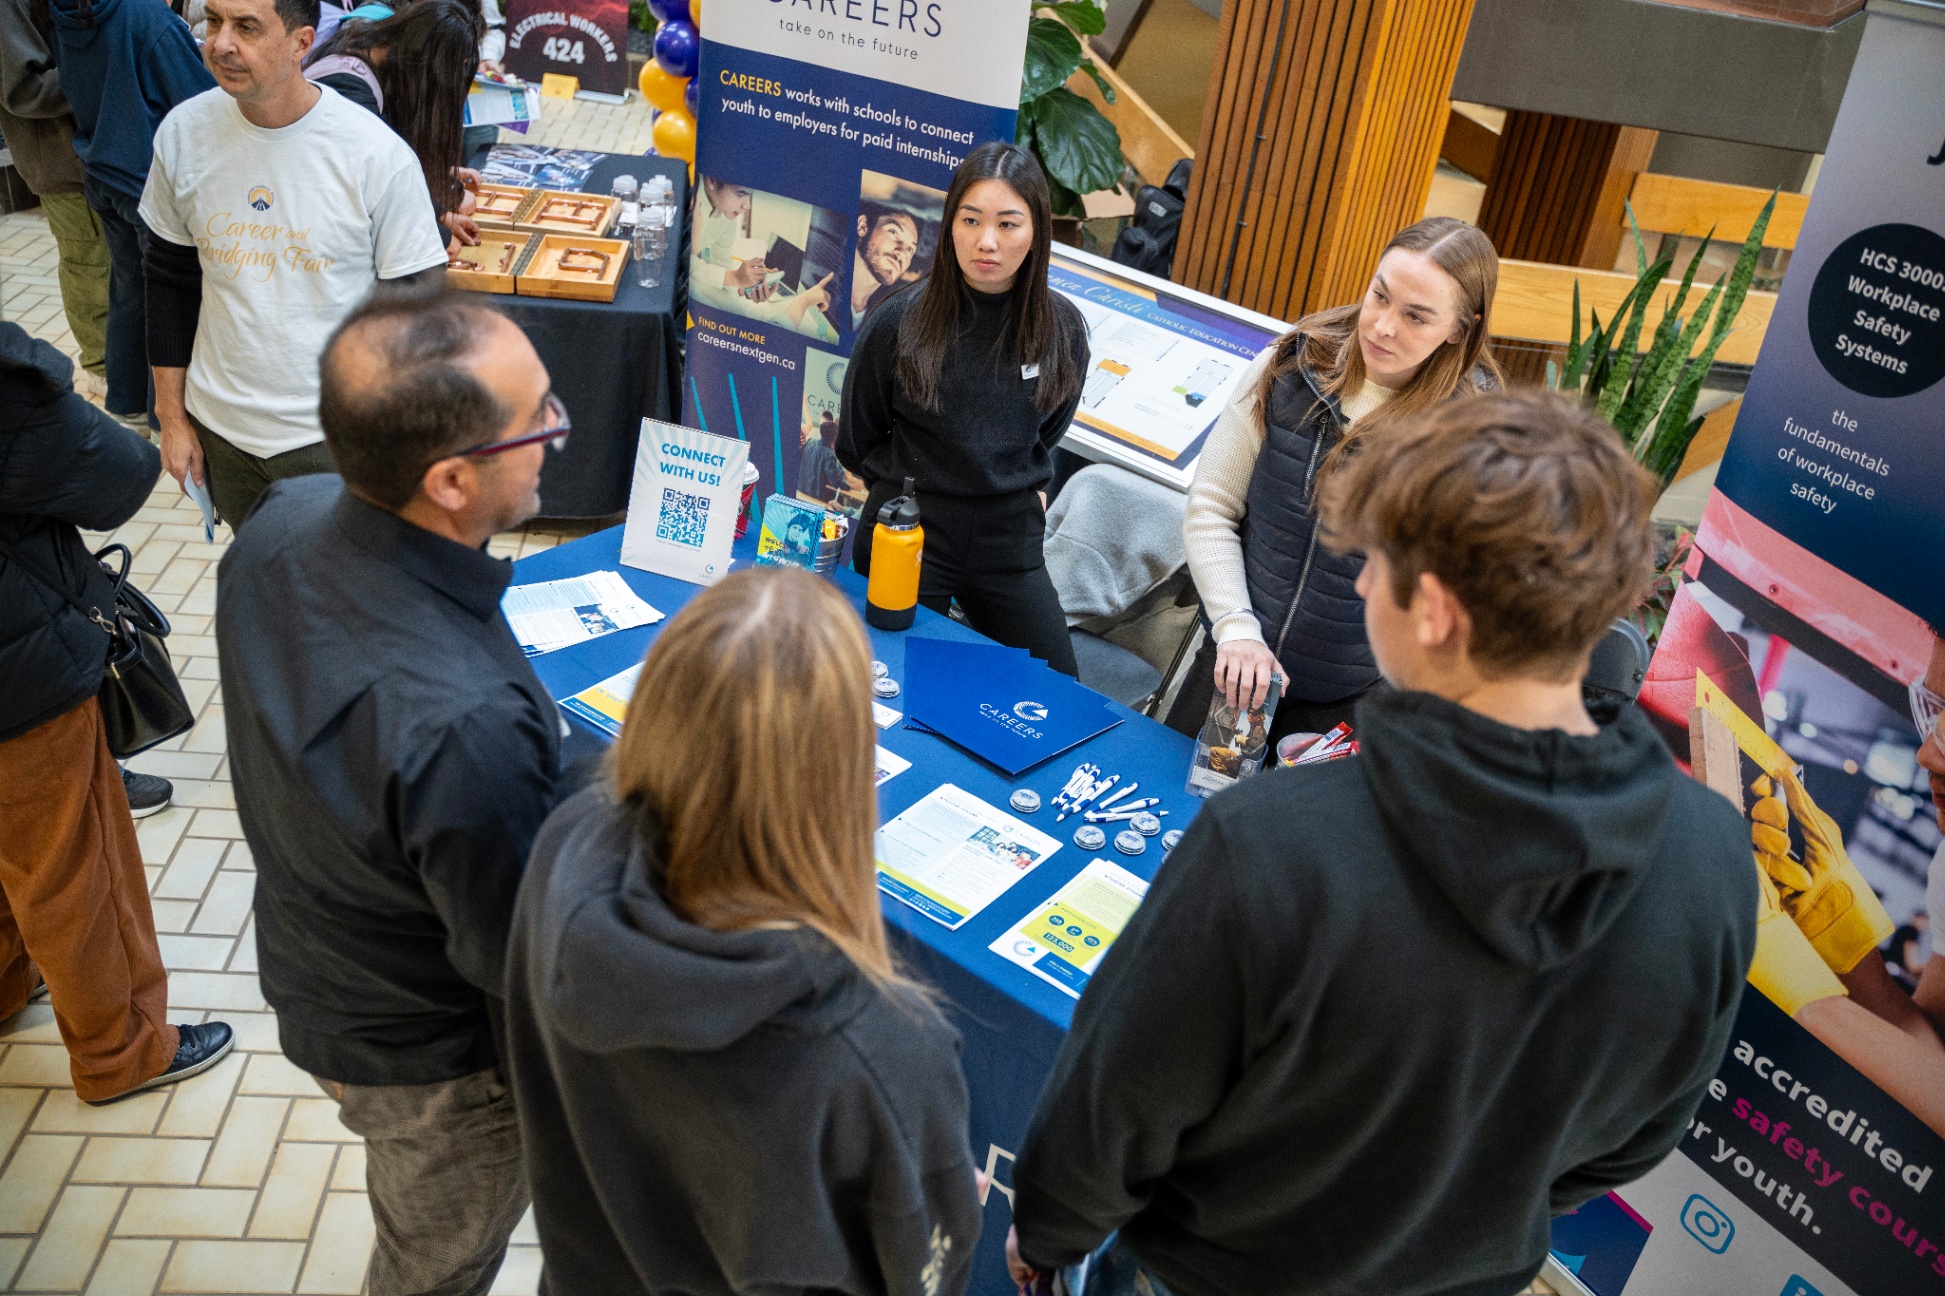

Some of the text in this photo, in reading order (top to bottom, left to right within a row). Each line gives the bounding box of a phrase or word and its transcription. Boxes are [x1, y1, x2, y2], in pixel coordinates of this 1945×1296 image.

[508, 11, 618, 62] ELECTRICAL WORKERS
[769, 0, 942, 38] EERS
[780, 18, 918, 60] take on the future
[542, 36, 585, 65] 424
[720, 69, 974, 145] CAREERS works with schools to connect
[721, 97, 755, 116] youth
[758, 103, 771, 119] to
[774, 111, 837, 136] employers
[840, 122, 860, 142] for
[862, 132, 893, 150] paid
[206, 212, 311, 241] Career and
[195, 237, 335, 283] Bridging Fair
[1860, 247, 1898, 274] HCS
[1048, 274, 1082, 291] men
[1147, 312, 1190, 332] CATHOLIC
[1188, 327, 1240, 351] EDUCATION
[1239, 346, 1258, 358] CEN
[1847, 274, 1941, 322] Workplace
[698, 316, 766, 345] FIND OUT MORE
[1853, 309, 1912, 346] Safety
[697, 331, 796, 371] careersnextgen.ca
[1835, 333, 1908, 375] Systems
[807, 394, 841, 414] CARE
[1831, 409, 1858, 432] the
[661, 443, 726, 468] CONNECT
[1783, 417, 1890, 477] fundamentals
[659, 461, 721, 487] WITH US!
[1777, 446, 1876, 500] of workplace
[1790, 481, 1838, 514] safety
[980, 703, 1044, 739] CAREERS
[1733, 1039, 1934, 1194] accredited
[1710, 1136, 1821, 1235] youth.
[1732, 1097, 1945, 1279] safety cours
